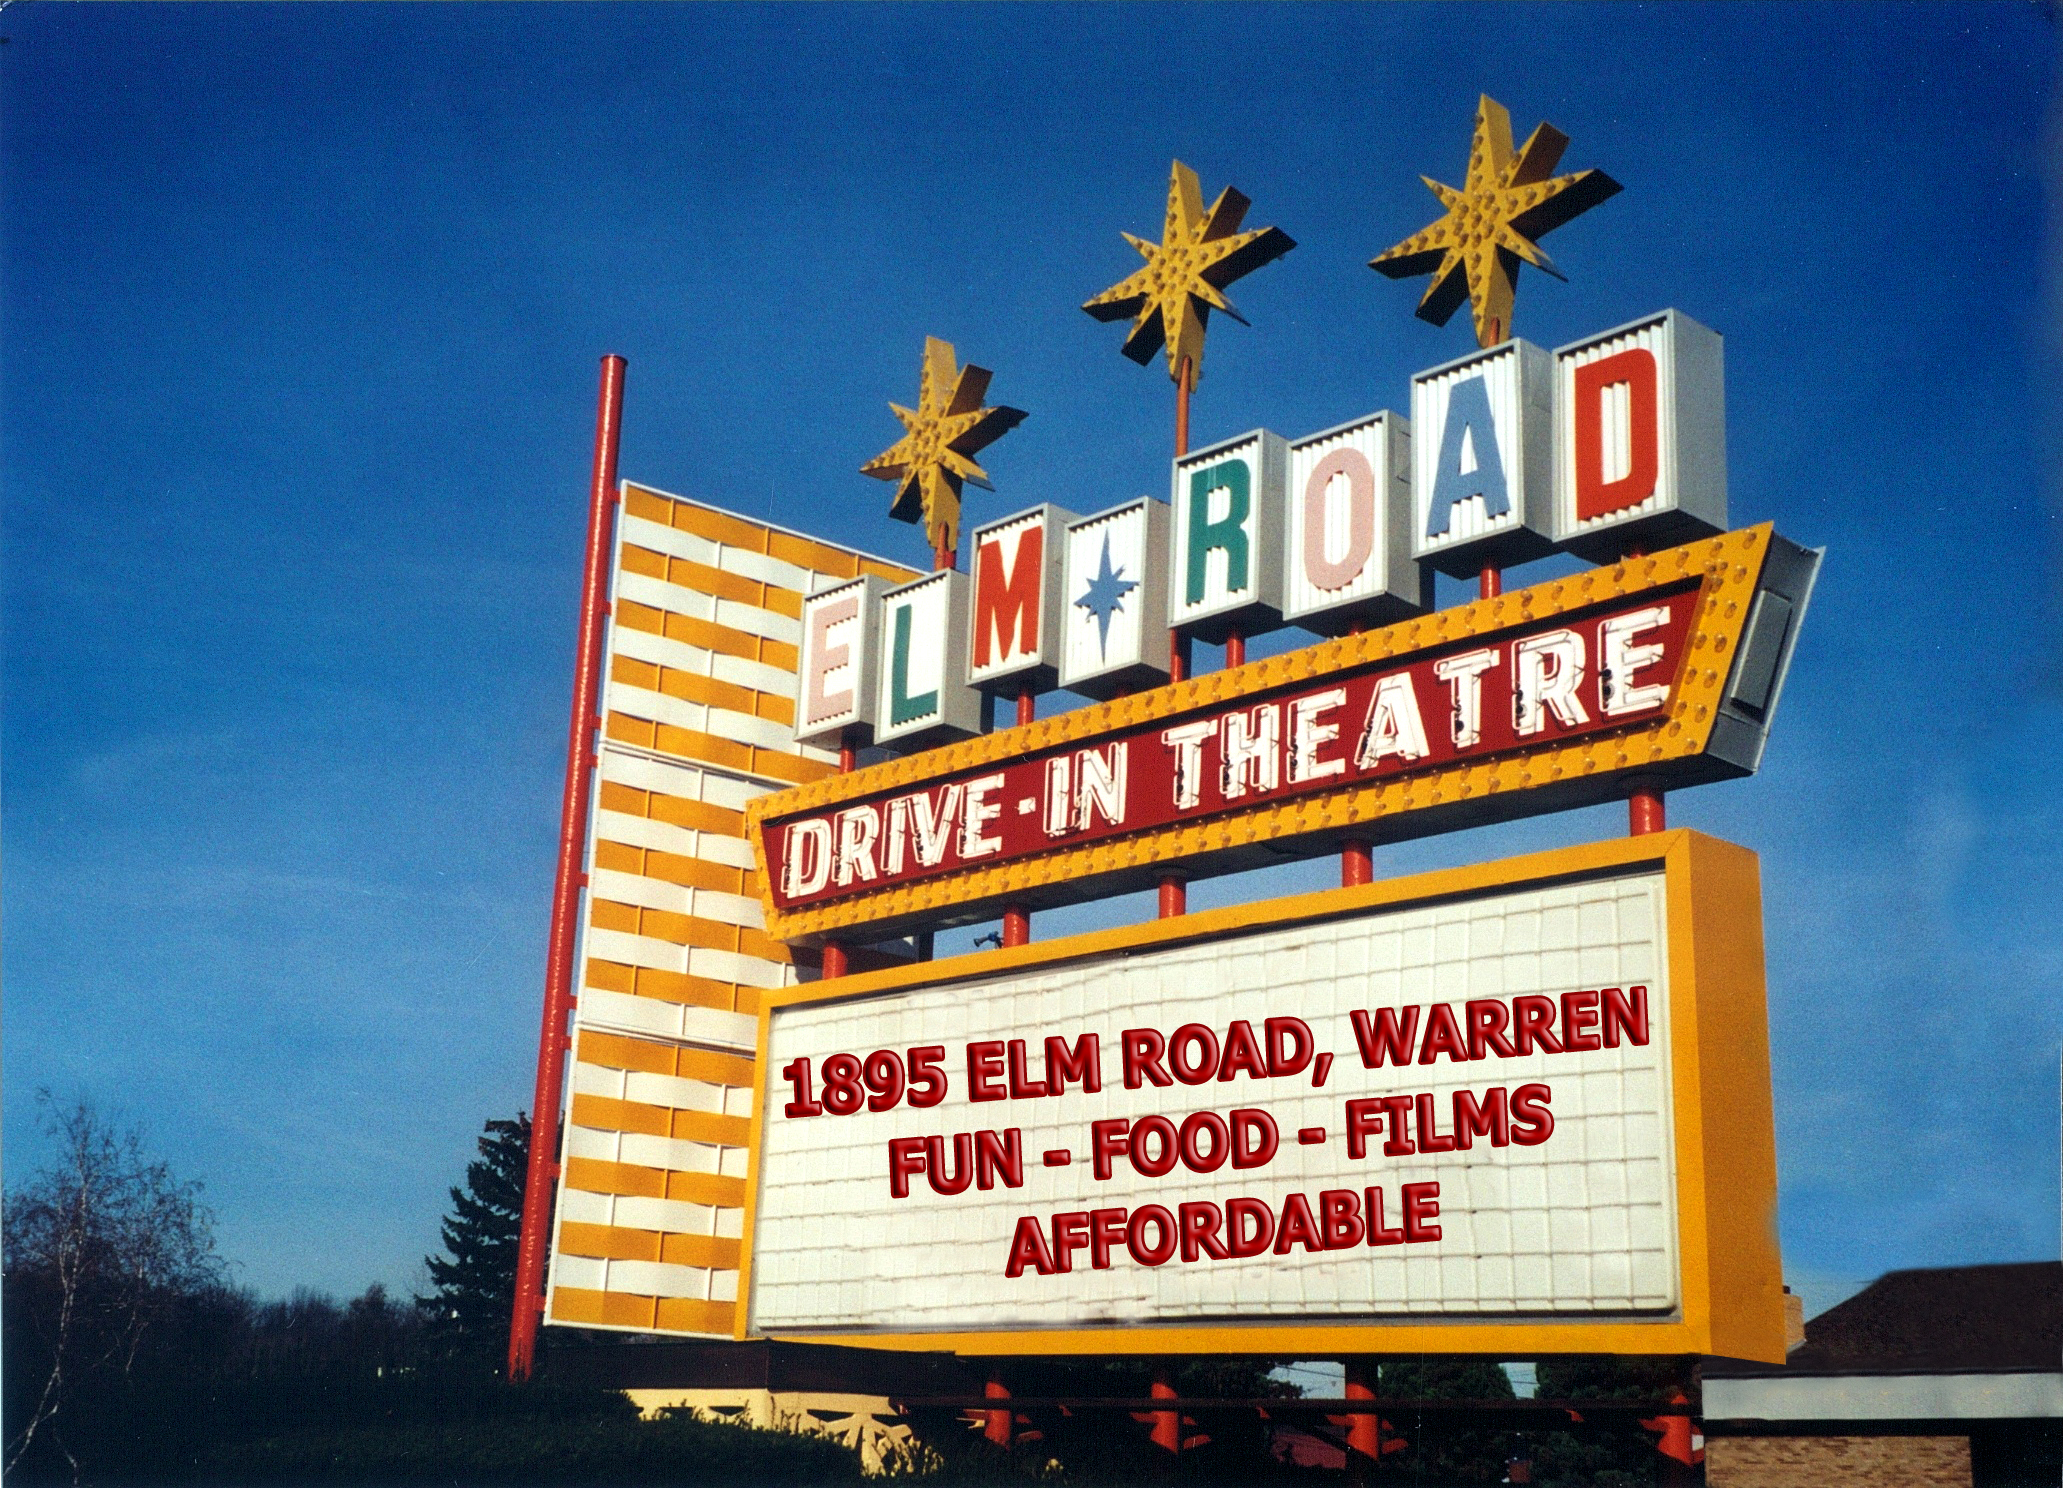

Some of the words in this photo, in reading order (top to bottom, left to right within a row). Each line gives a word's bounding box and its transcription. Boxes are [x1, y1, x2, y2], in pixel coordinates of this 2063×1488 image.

[807, 525, 1043, 727] ELM
[1186, 348, 1658, 606] ROAD
[1162, 605, 1671, 810] THEATRE
[783, 1045, 948, 1119] 1895
[966, 1033, 1101, 1102] ELM
[1121, 1016, 1334, 1090] ROAD,
[1350, 985, 1649, 1068] WARREN
[888, 1127, 1023, 1198] FUN
[1043, 1149, 1071, 1167] -
[1091, 1108, 1279, 1180] FOOD
[1298, 1127, 1326, 1145] -
[1345, 1083, 1554, 1159] FILMS
[1005, 1181, 1442, 1278] AFFORDABLE
